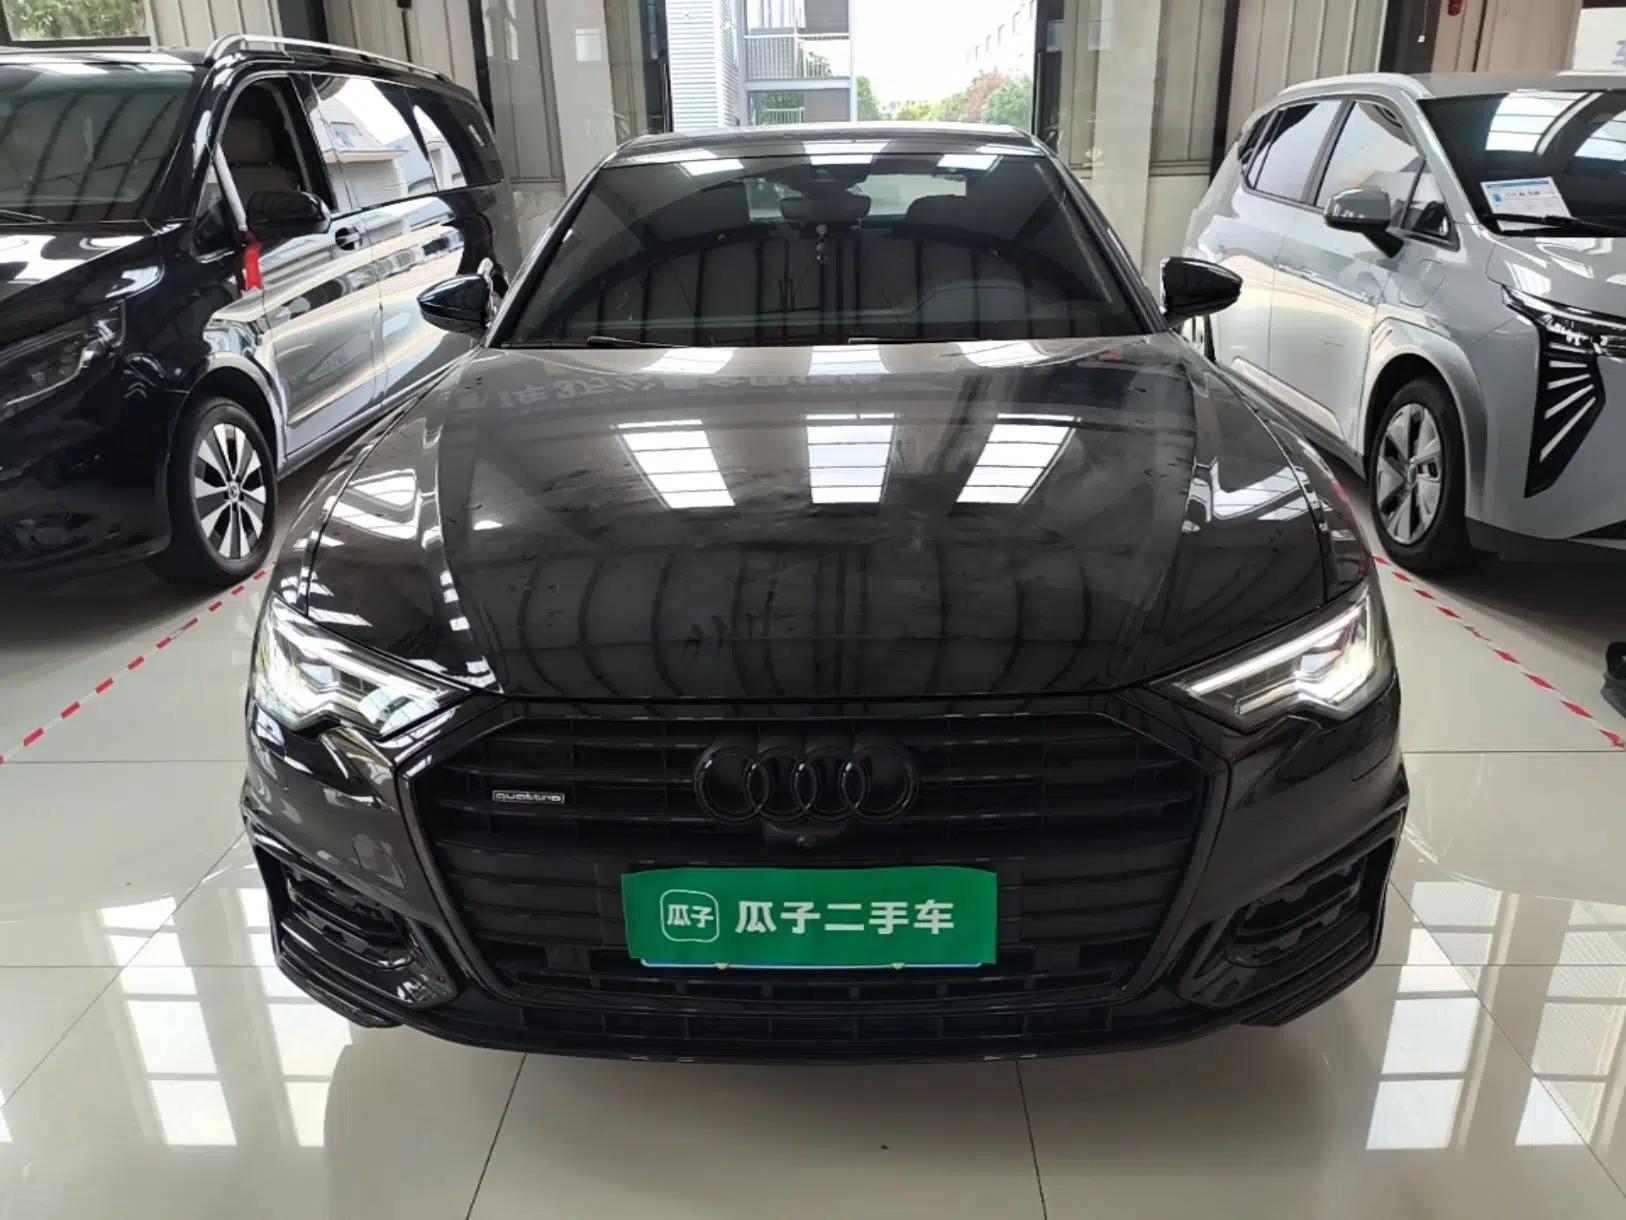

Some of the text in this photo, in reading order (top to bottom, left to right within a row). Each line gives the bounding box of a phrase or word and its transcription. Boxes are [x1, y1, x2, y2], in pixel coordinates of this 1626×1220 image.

[495, 791, 562, 802] quattro
[667, 904, 714, 928] 瓜子
[735, 899, 955, 935] 瓜子二手车
